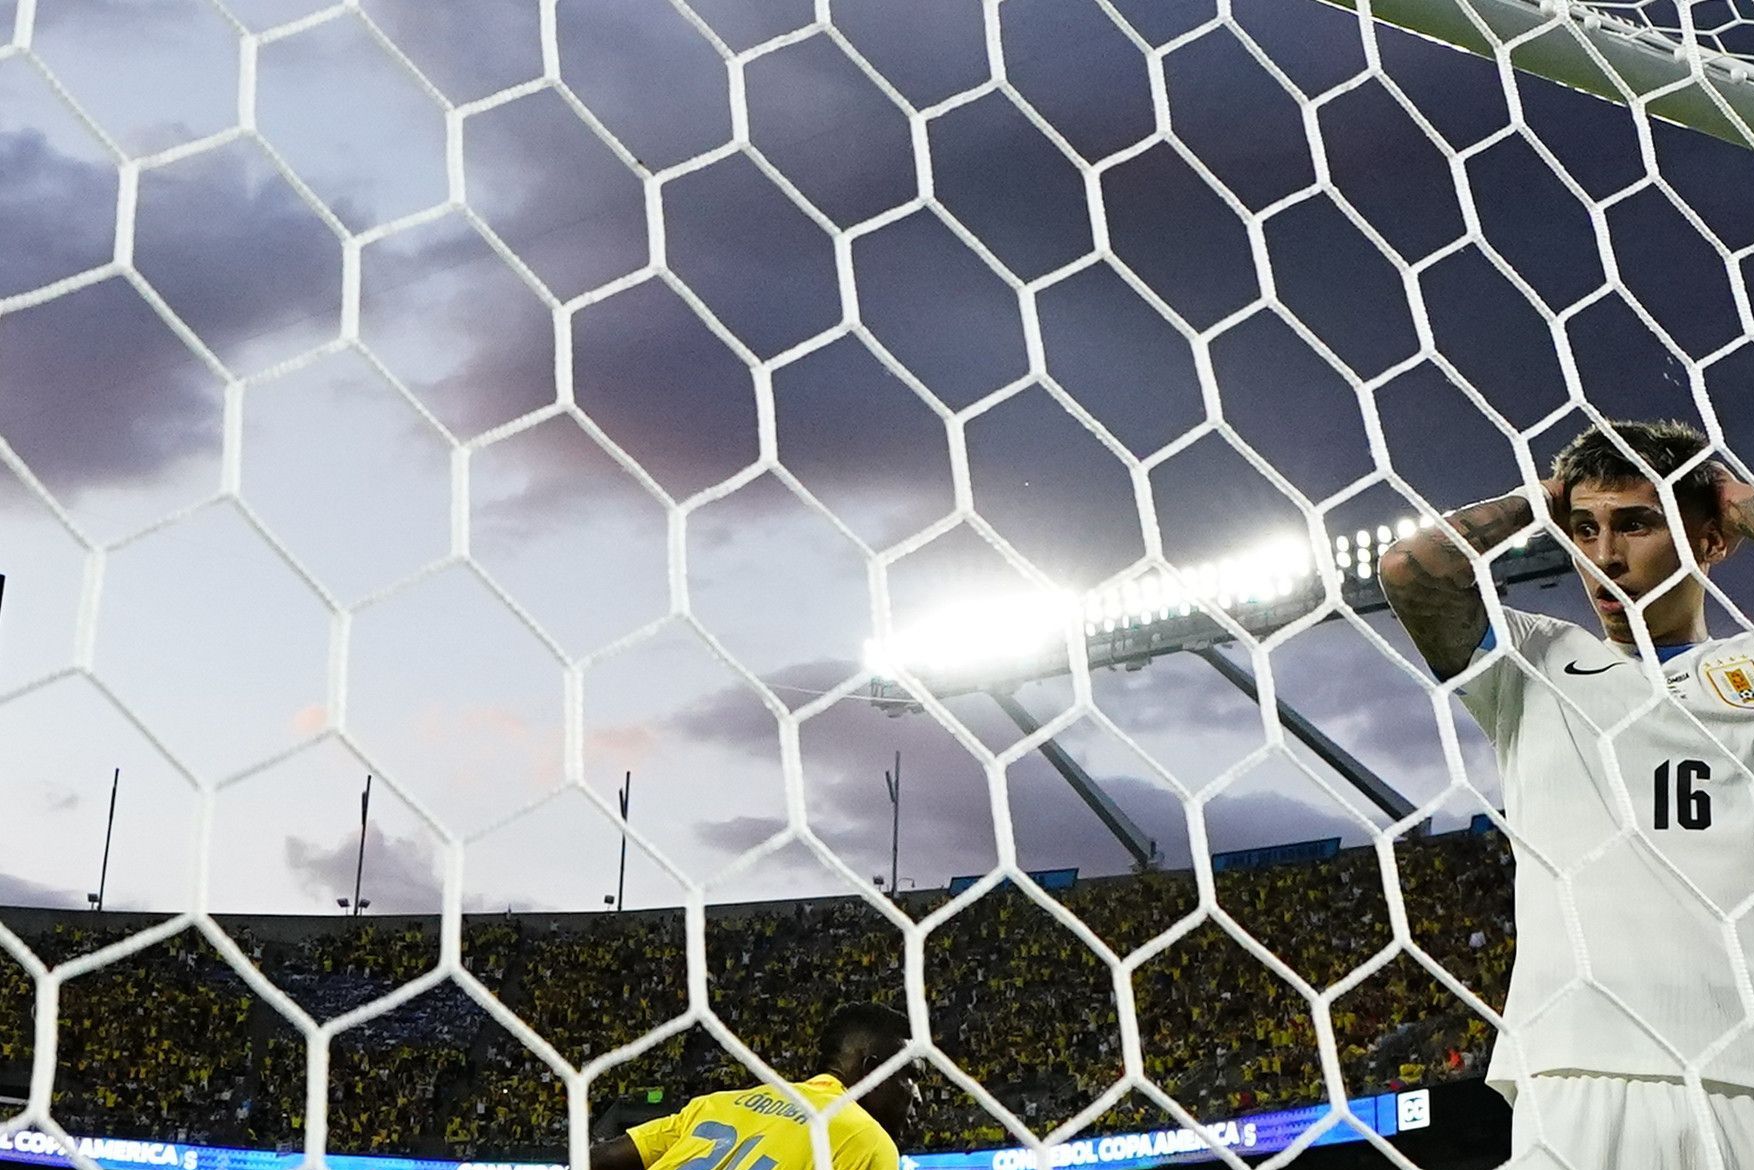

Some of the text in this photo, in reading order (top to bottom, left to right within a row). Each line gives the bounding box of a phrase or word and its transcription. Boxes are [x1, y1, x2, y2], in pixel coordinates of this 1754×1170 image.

[1654, 759, 1712, 830] 16
[78, 1137, 178, 1166] AMERICA
[1098, 1132, 1151, 1163] COPA
